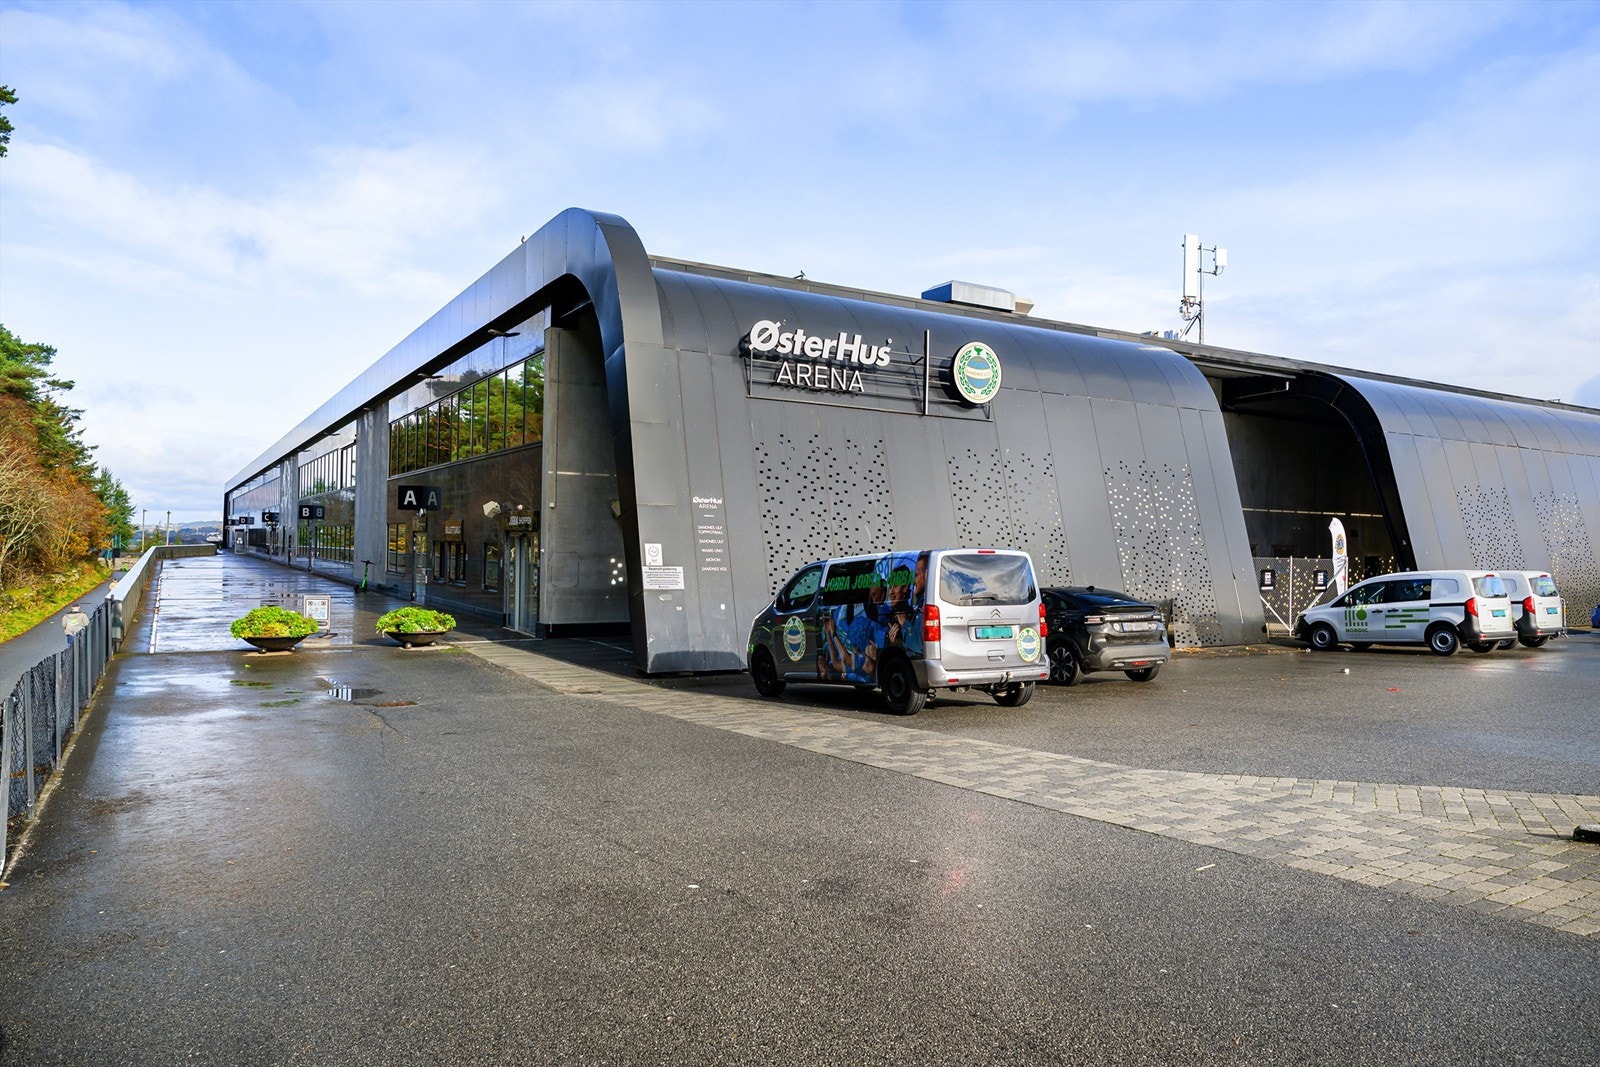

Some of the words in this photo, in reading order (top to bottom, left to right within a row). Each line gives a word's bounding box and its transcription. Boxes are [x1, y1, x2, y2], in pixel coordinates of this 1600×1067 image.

[749, 319, 892, 367] ØsterHus
[777, 362, 864, 393] ARENA
[403, 490, 417, 505] A
[264, 513, 270, 521] C
[302, 507, 310, 517] B
[824, 576, 850, 592] JOBBA
[852, 573, 882, 590] JOBBA
[884, 570, 914, 587] JOBBA
